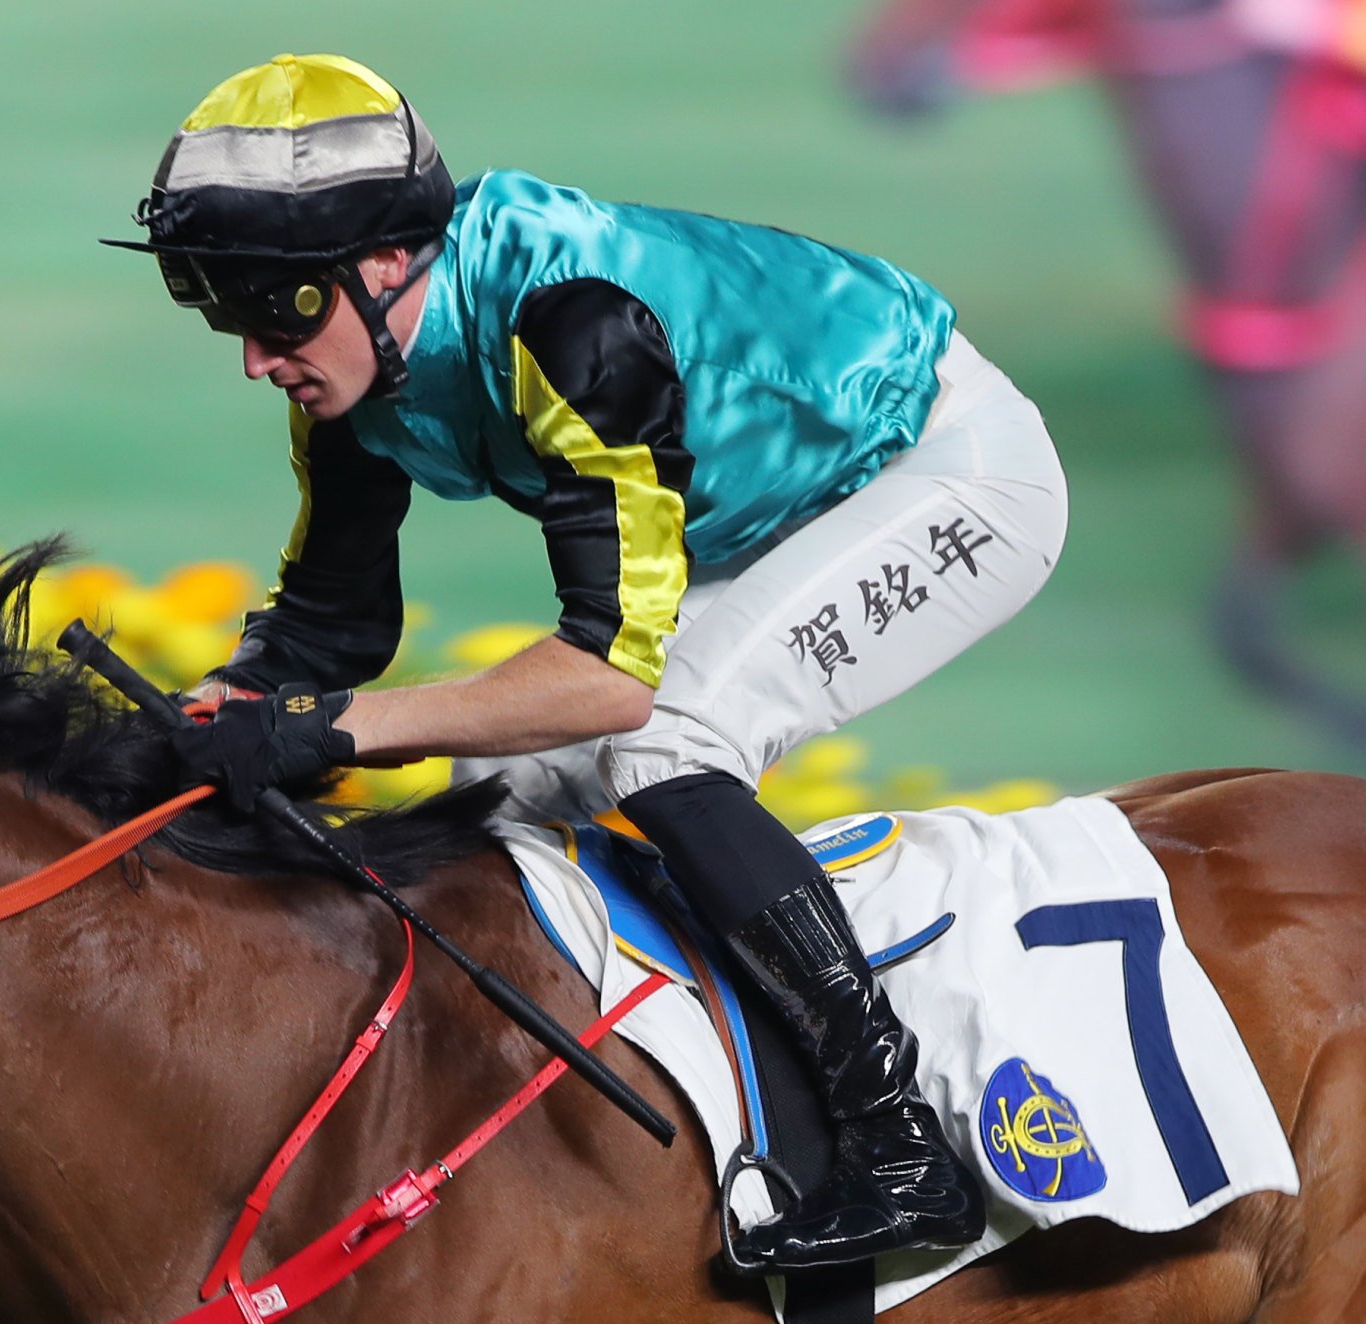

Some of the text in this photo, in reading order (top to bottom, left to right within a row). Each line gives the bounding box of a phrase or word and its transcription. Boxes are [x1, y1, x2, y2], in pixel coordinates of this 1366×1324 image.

[788, 517, 993, 688] 賀銘年
[808, 828, 869, 854] amelin
[1014, 898, 1230, 1206] 7
